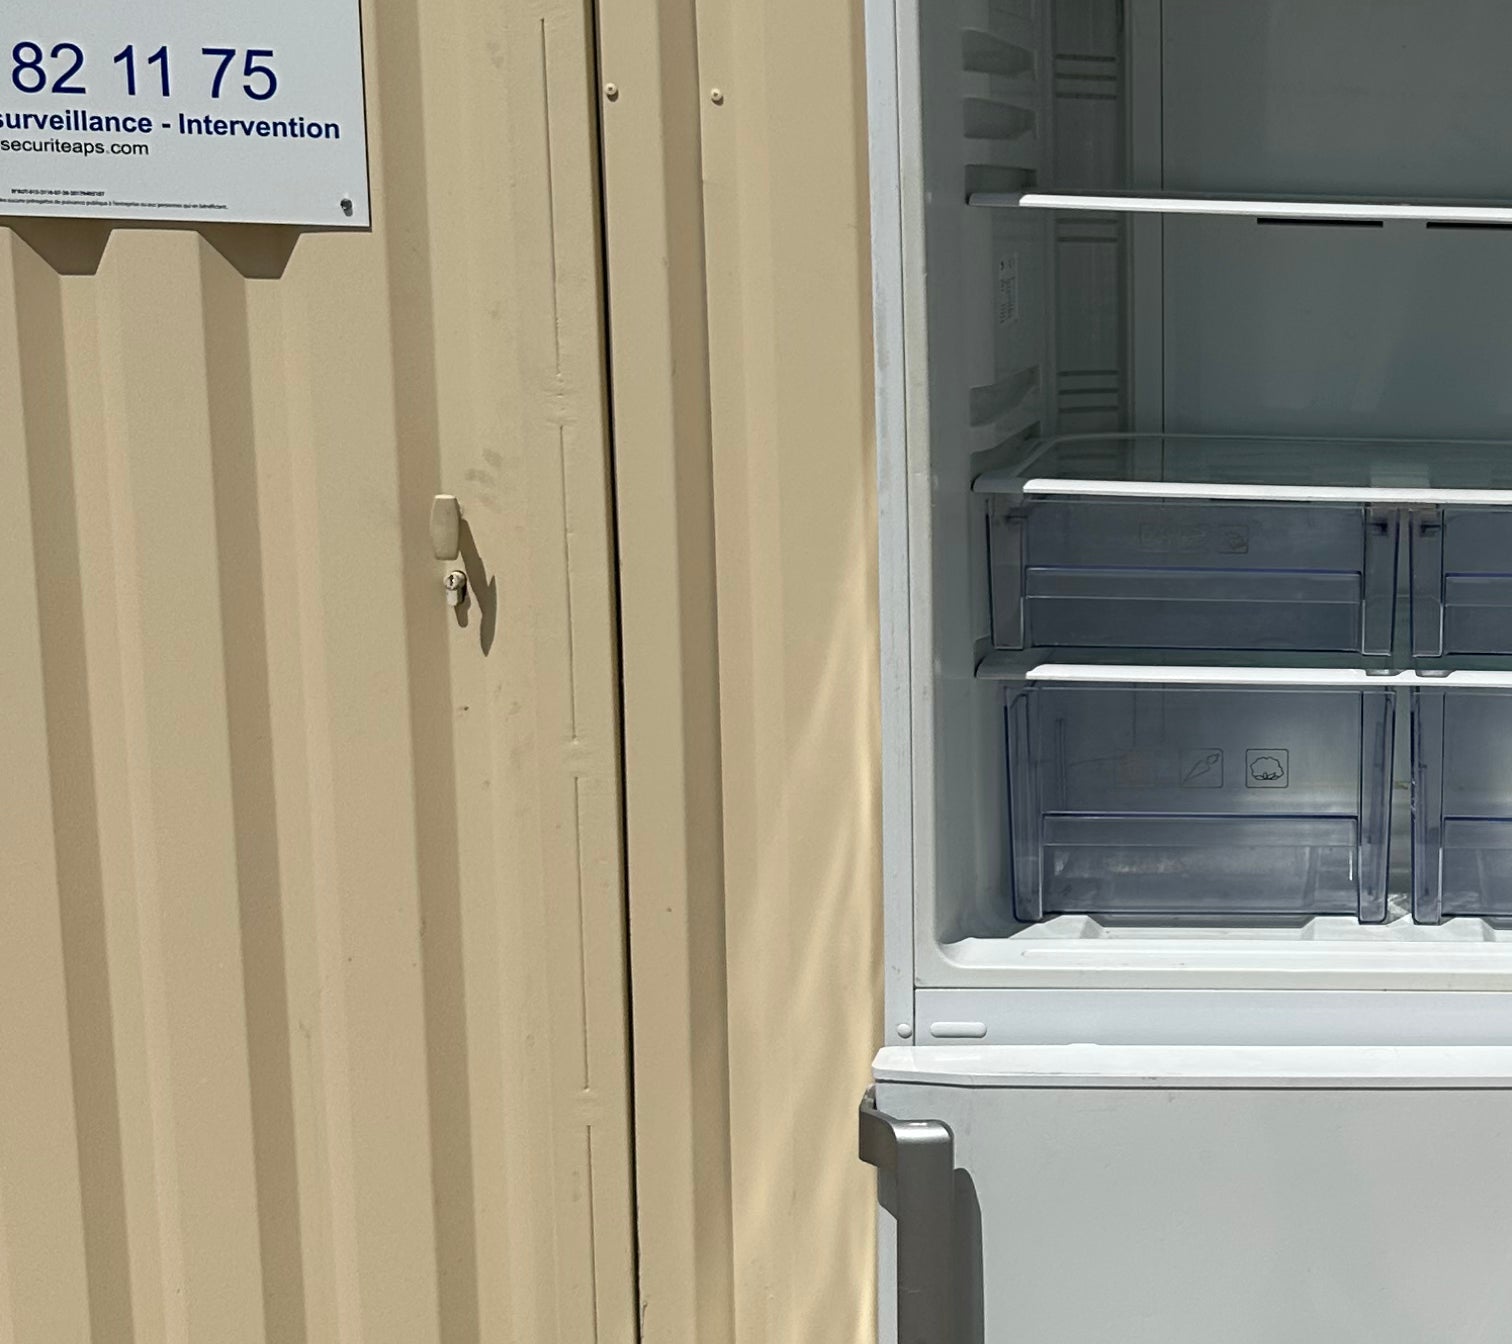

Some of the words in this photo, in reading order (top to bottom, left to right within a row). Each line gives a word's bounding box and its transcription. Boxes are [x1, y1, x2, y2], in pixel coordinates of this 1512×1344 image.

[12, 41, 86, 94] 82
[114, 44, 170, 97] 11
[202, 47, 278, 100] 75
[178, 113, 340, 139] Intervention
[1, 138, 149, 157] securiteaps.com
